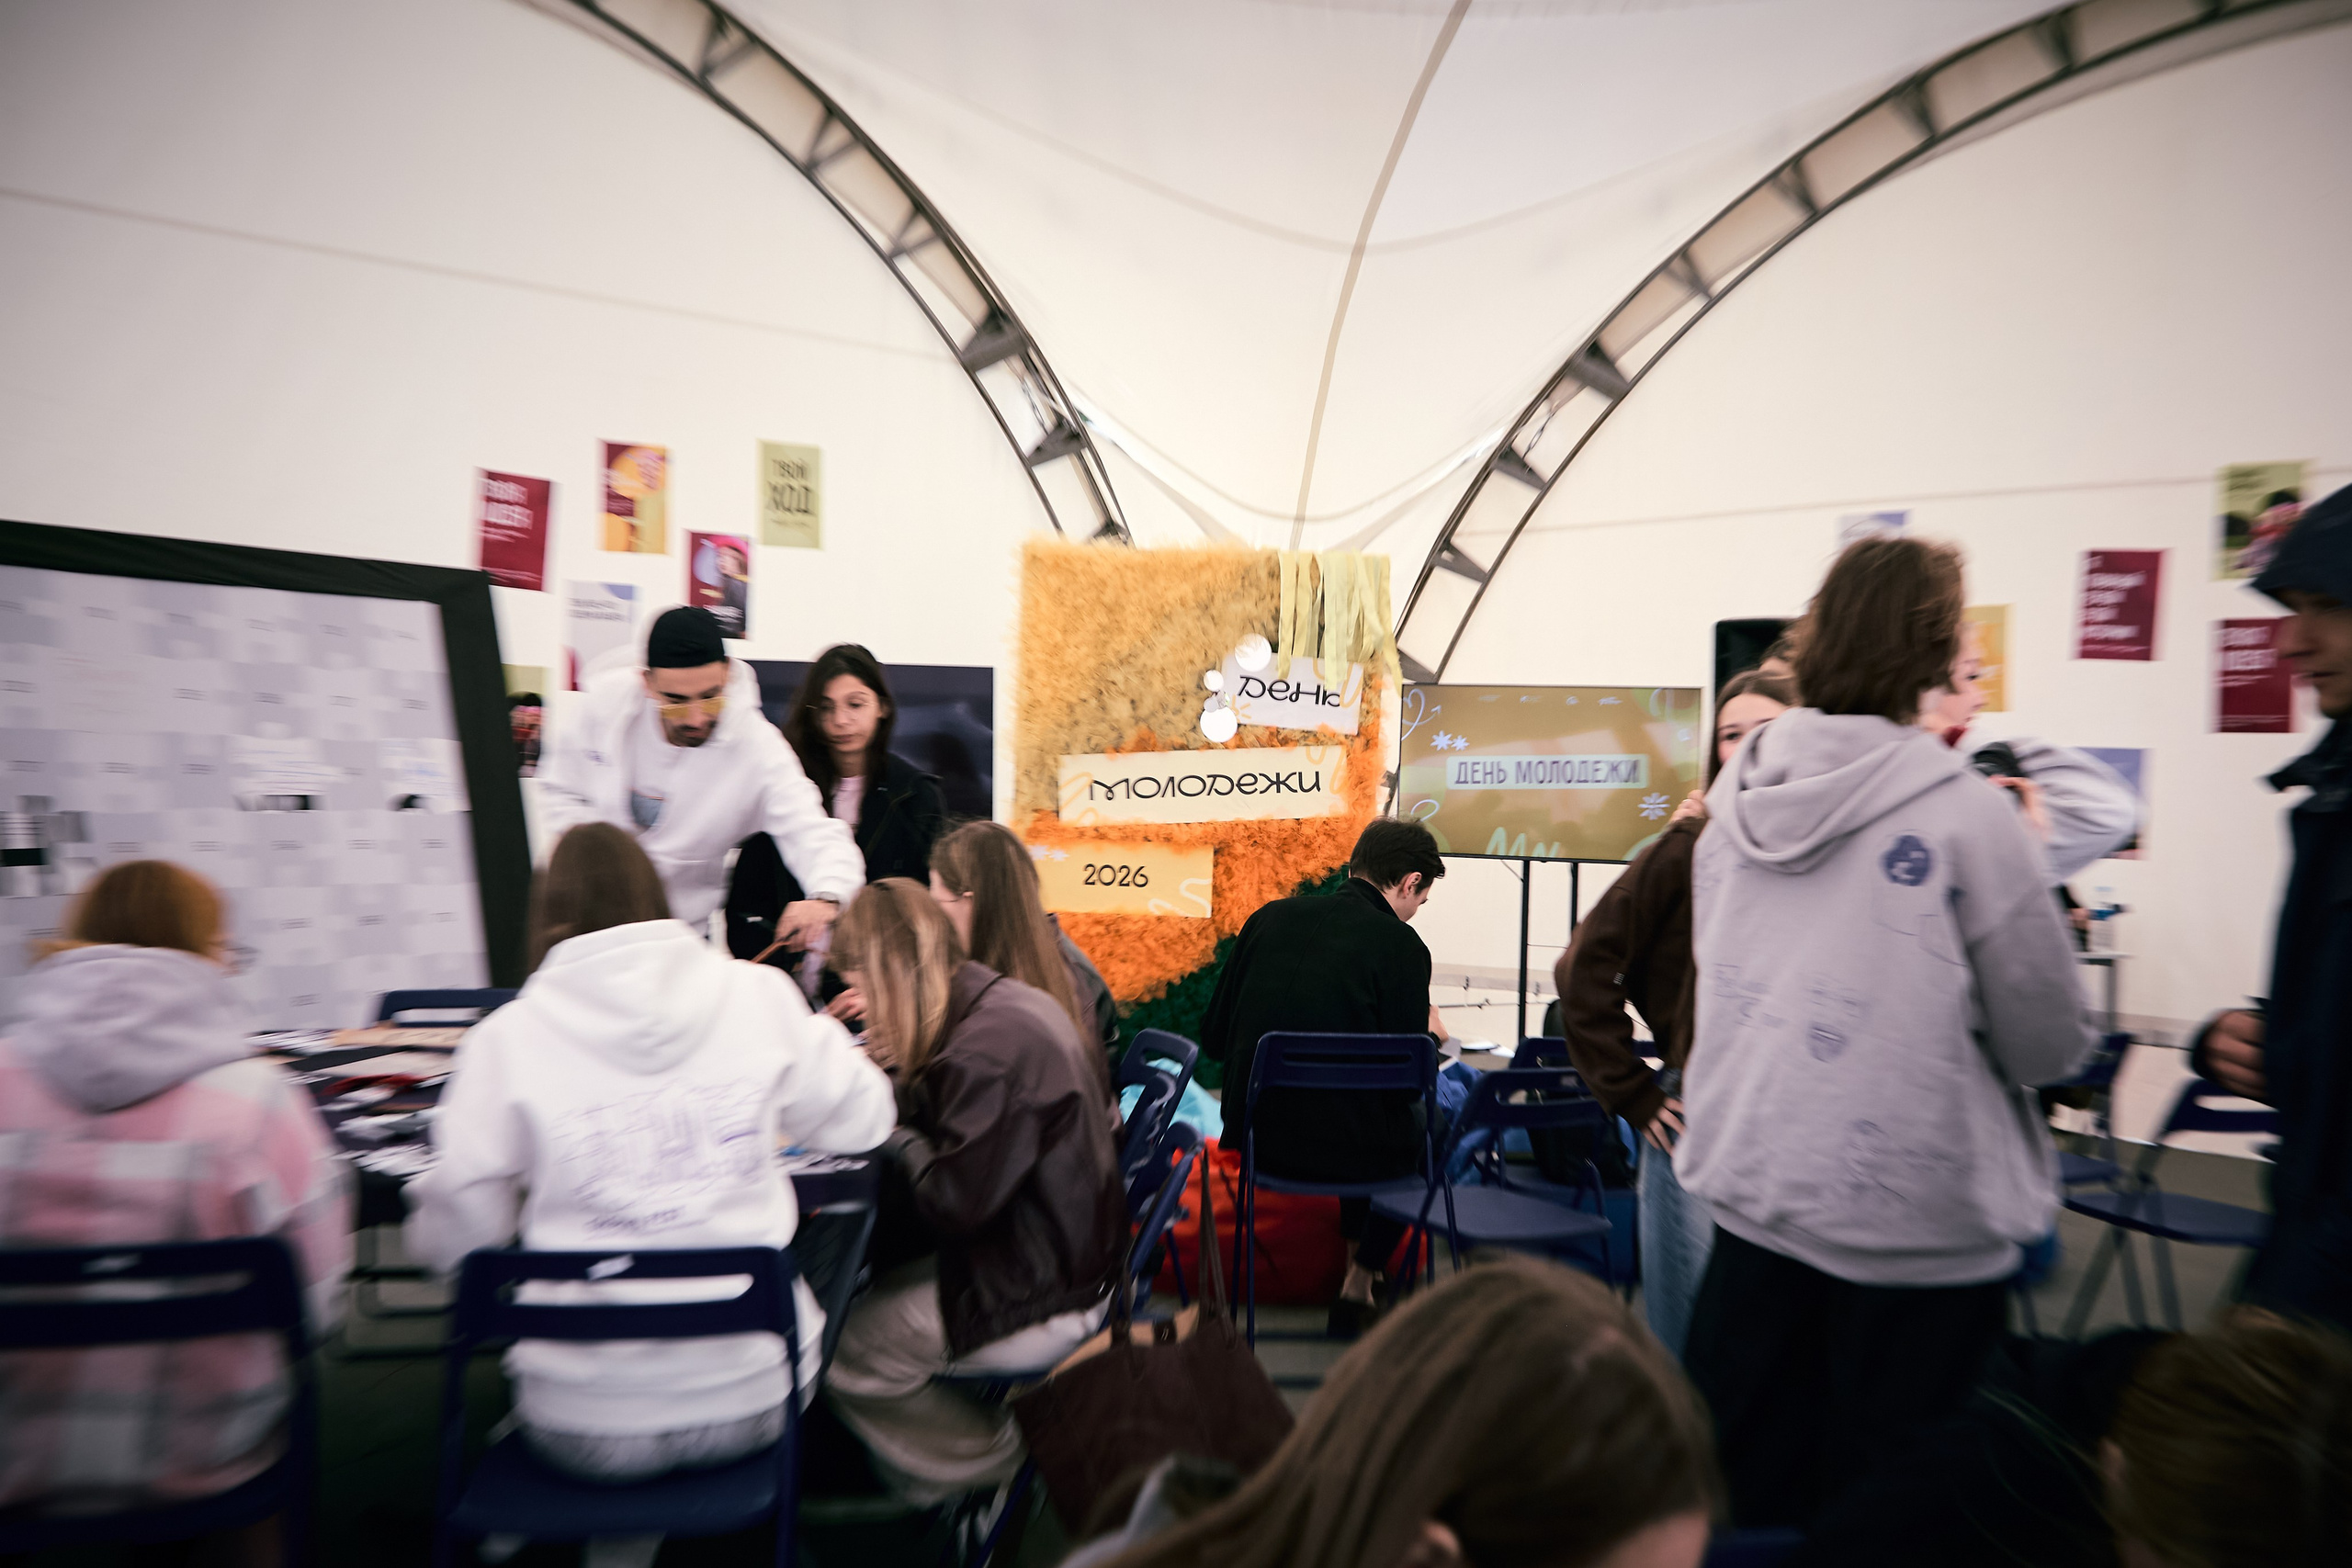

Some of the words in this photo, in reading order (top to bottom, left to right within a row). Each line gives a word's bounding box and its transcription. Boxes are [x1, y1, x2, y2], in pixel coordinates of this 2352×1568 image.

[1454, 761, 1508, 784] ДЕНЬ
[1515, 759, 1642, 784] МОЛОДЕЖИ
[1083, 863, 1149, 888] 2026
